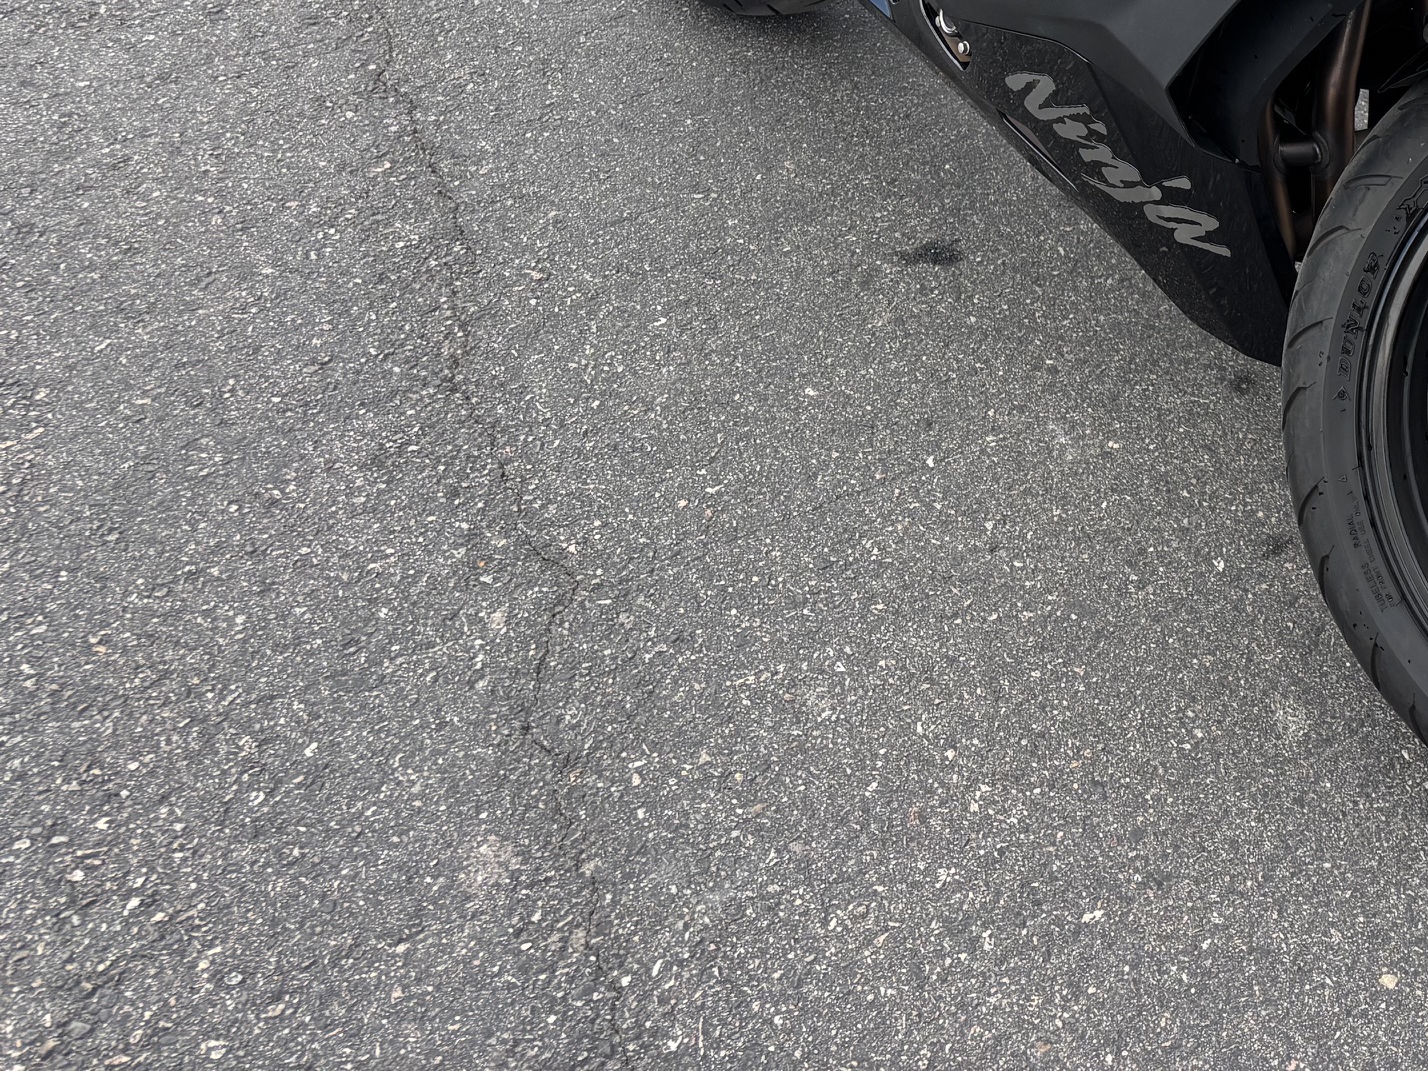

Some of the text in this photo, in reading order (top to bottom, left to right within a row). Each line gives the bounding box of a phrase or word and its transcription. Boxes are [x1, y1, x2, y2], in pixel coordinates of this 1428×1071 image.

[1004, 71, 1231, 258] Ninja
[1336, 251, 1381, 382] DUNLOP
[1346, 514, 1361, 549] RADIAL
[1361, 563, 1388, 613] TUBELESS
